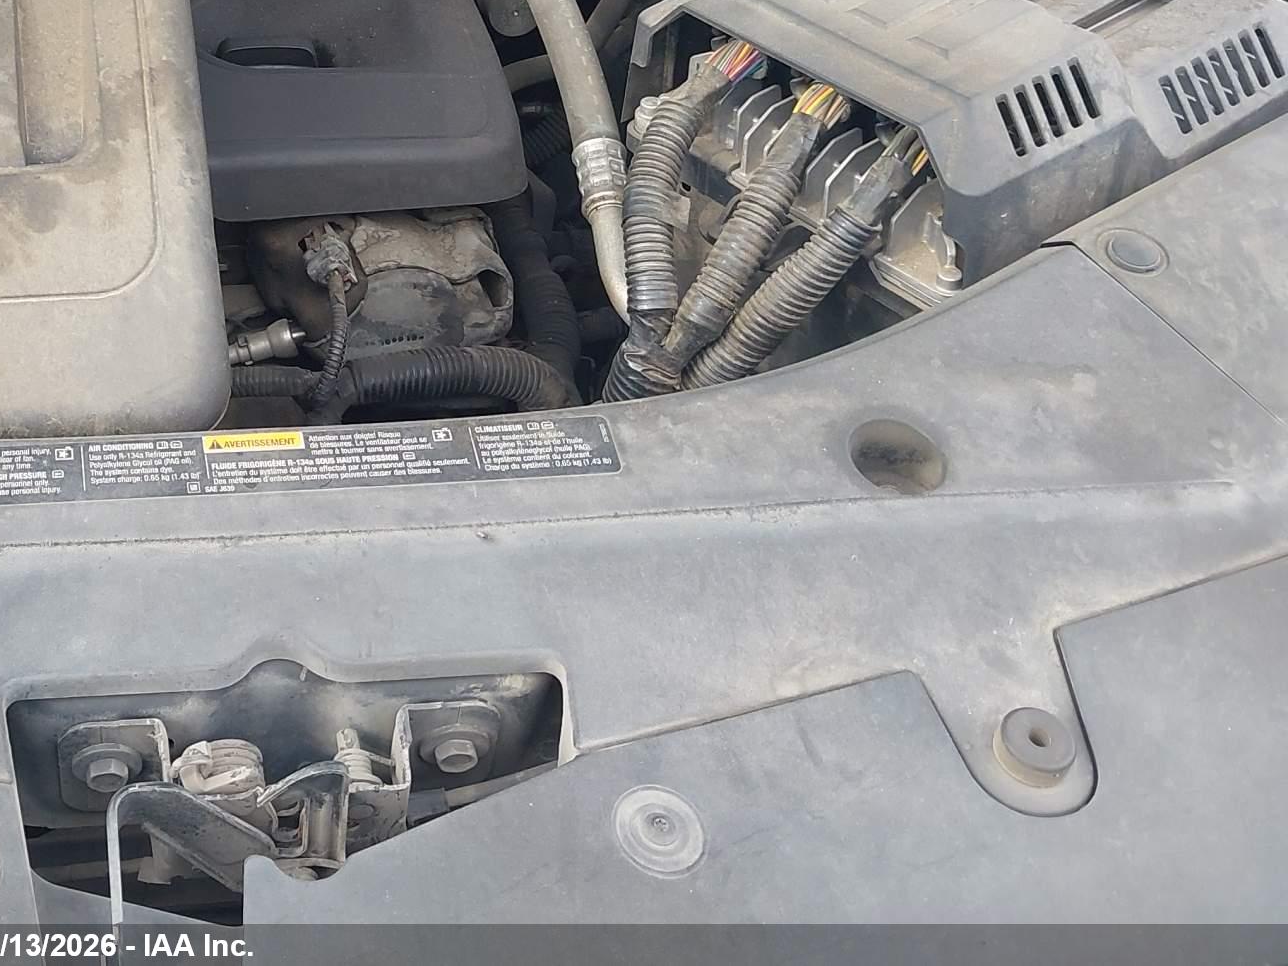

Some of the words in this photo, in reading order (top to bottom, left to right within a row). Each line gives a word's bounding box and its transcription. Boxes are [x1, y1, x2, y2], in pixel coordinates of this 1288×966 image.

[475, 424, 523, 433] CLIMATISEUR
[308, 434, 338, 442] Attention
[224, 437, 296, 448] AVERTISSEMENT
[102, 443, 154, 452] CONDITIONING
[2, 449, 29, 457] personal
[103, 453, 117, 461] only
[211, 462, 237, 470] FLUIDE
[362, 453, 399, 462] PRESSION
[2, 464, 14, 472] any
[9, 471, 47, 479] PRESSURE
[11, 487, 40, 496] personal
